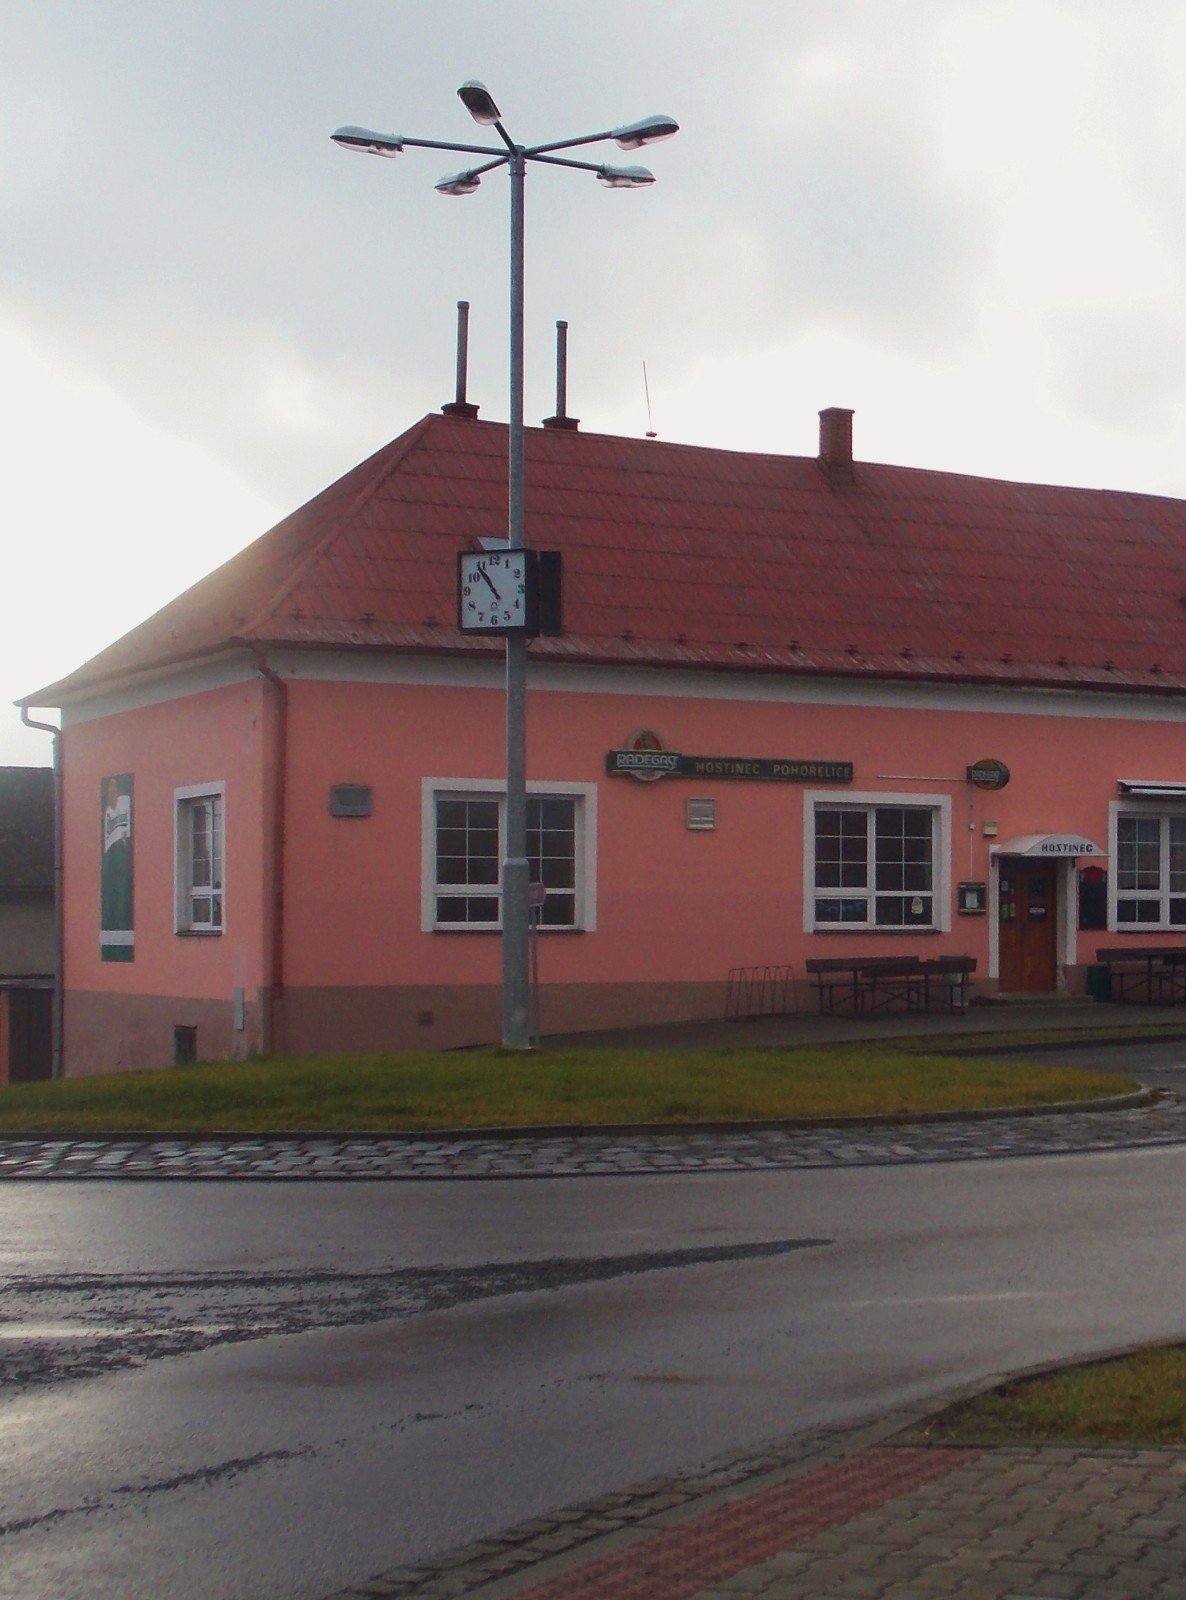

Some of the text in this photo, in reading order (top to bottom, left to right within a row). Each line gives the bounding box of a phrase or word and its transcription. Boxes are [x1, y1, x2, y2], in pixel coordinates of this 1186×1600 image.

[489, 555, 501, 566] 12
[505, 559, 510, 569] 1
[468, 572, 480, 583] 10
[513, 569, 521, 579] 2
[464, 586, 471, 596] 9
[517, 584, 525, 594] 3
[467, 601, 476, 611] 8
[513, 598, 520, 609] 4
[478, 612, 485, 622] 7
[491, 615, 498, 626] 6
[504, 611, 511, 621] 5
[617, 753, 679, 770] RADEGAST
[695, 762, 760, 775] HOSTINEC
[1041, 843, 1093, 853] HOSTINEC
